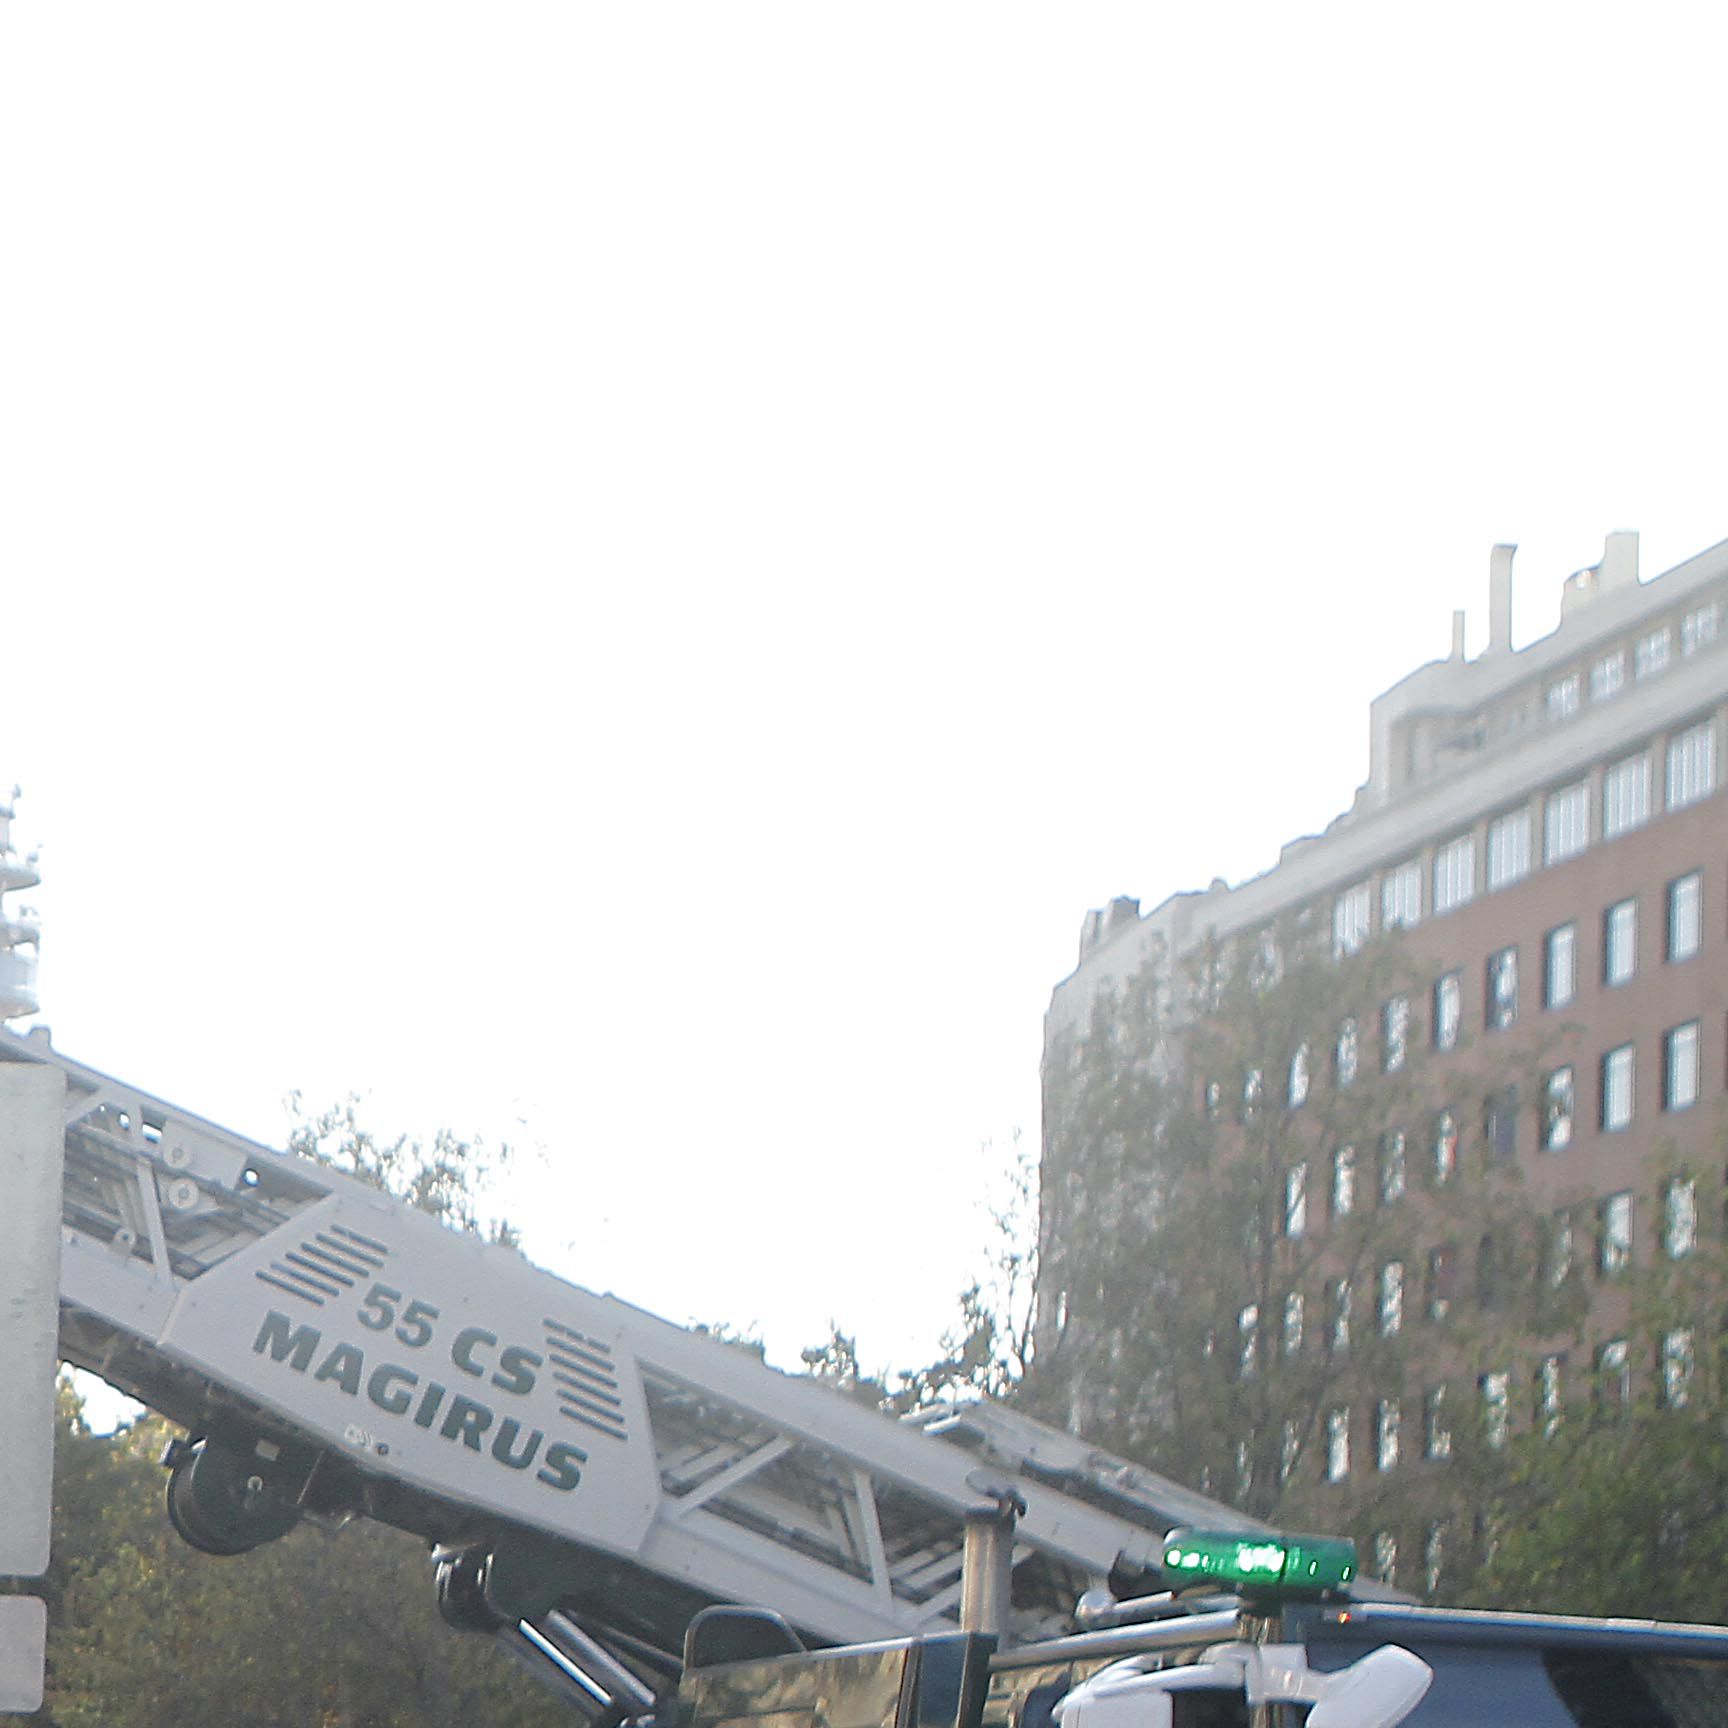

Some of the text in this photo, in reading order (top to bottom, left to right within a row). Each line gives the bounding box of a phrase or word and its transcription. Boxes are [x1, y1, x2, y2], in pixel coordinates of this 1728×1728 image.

[253, 1309, 588, 1491] MAGIRUS
[357, 1282, 544, 1396] 55 CS
